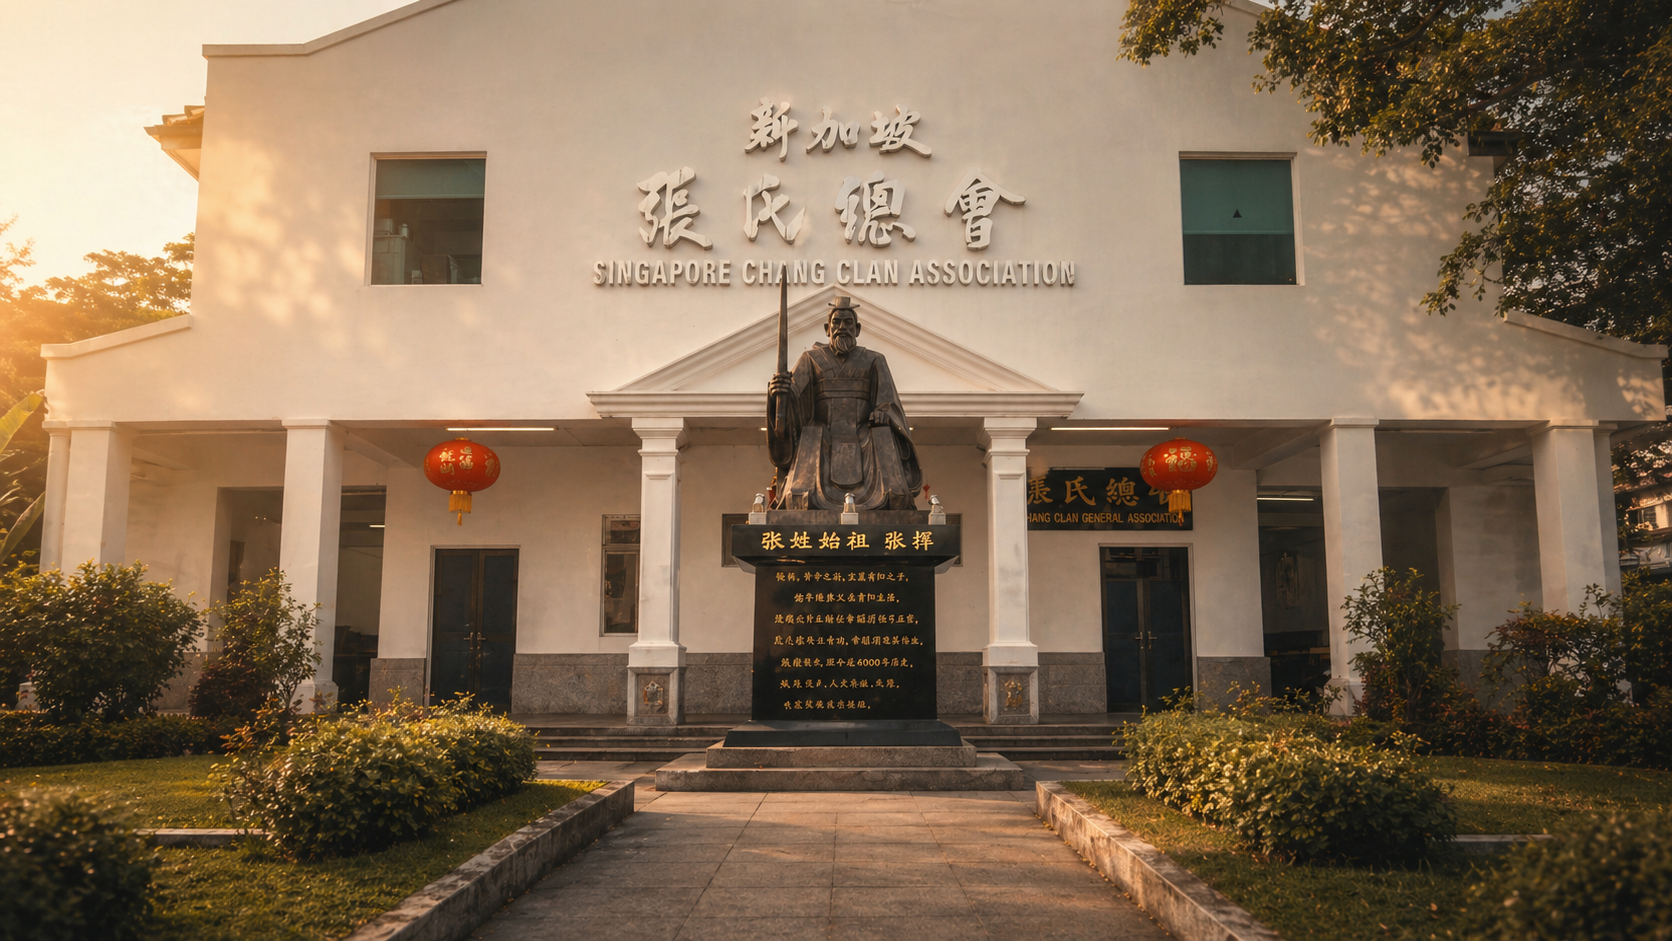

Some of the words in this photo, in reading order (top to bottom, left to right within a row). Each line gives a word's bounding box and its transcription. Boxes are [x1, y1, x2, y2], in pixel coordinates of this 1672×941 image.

[745, 96, 932, 161] 新加坡
[637, 166, 1026, 251] 張氏總會
[593, 259, 731, 286] SINGAPORE
[741, 259, 825, 286] CHANG
[837, 259, 898, 286] CLAN
[909, 259, 1075, 287] ASSOCIATION
[1027, 512, 1051, 523] HANG
[1054, 512, 1079, 523] CLAN
[1082, 512, 1123, 523] GENERAL
[1128, 512, 1183, 524] ASSOCIATIO
[761, 531, 870, 551] 张姓始祖
